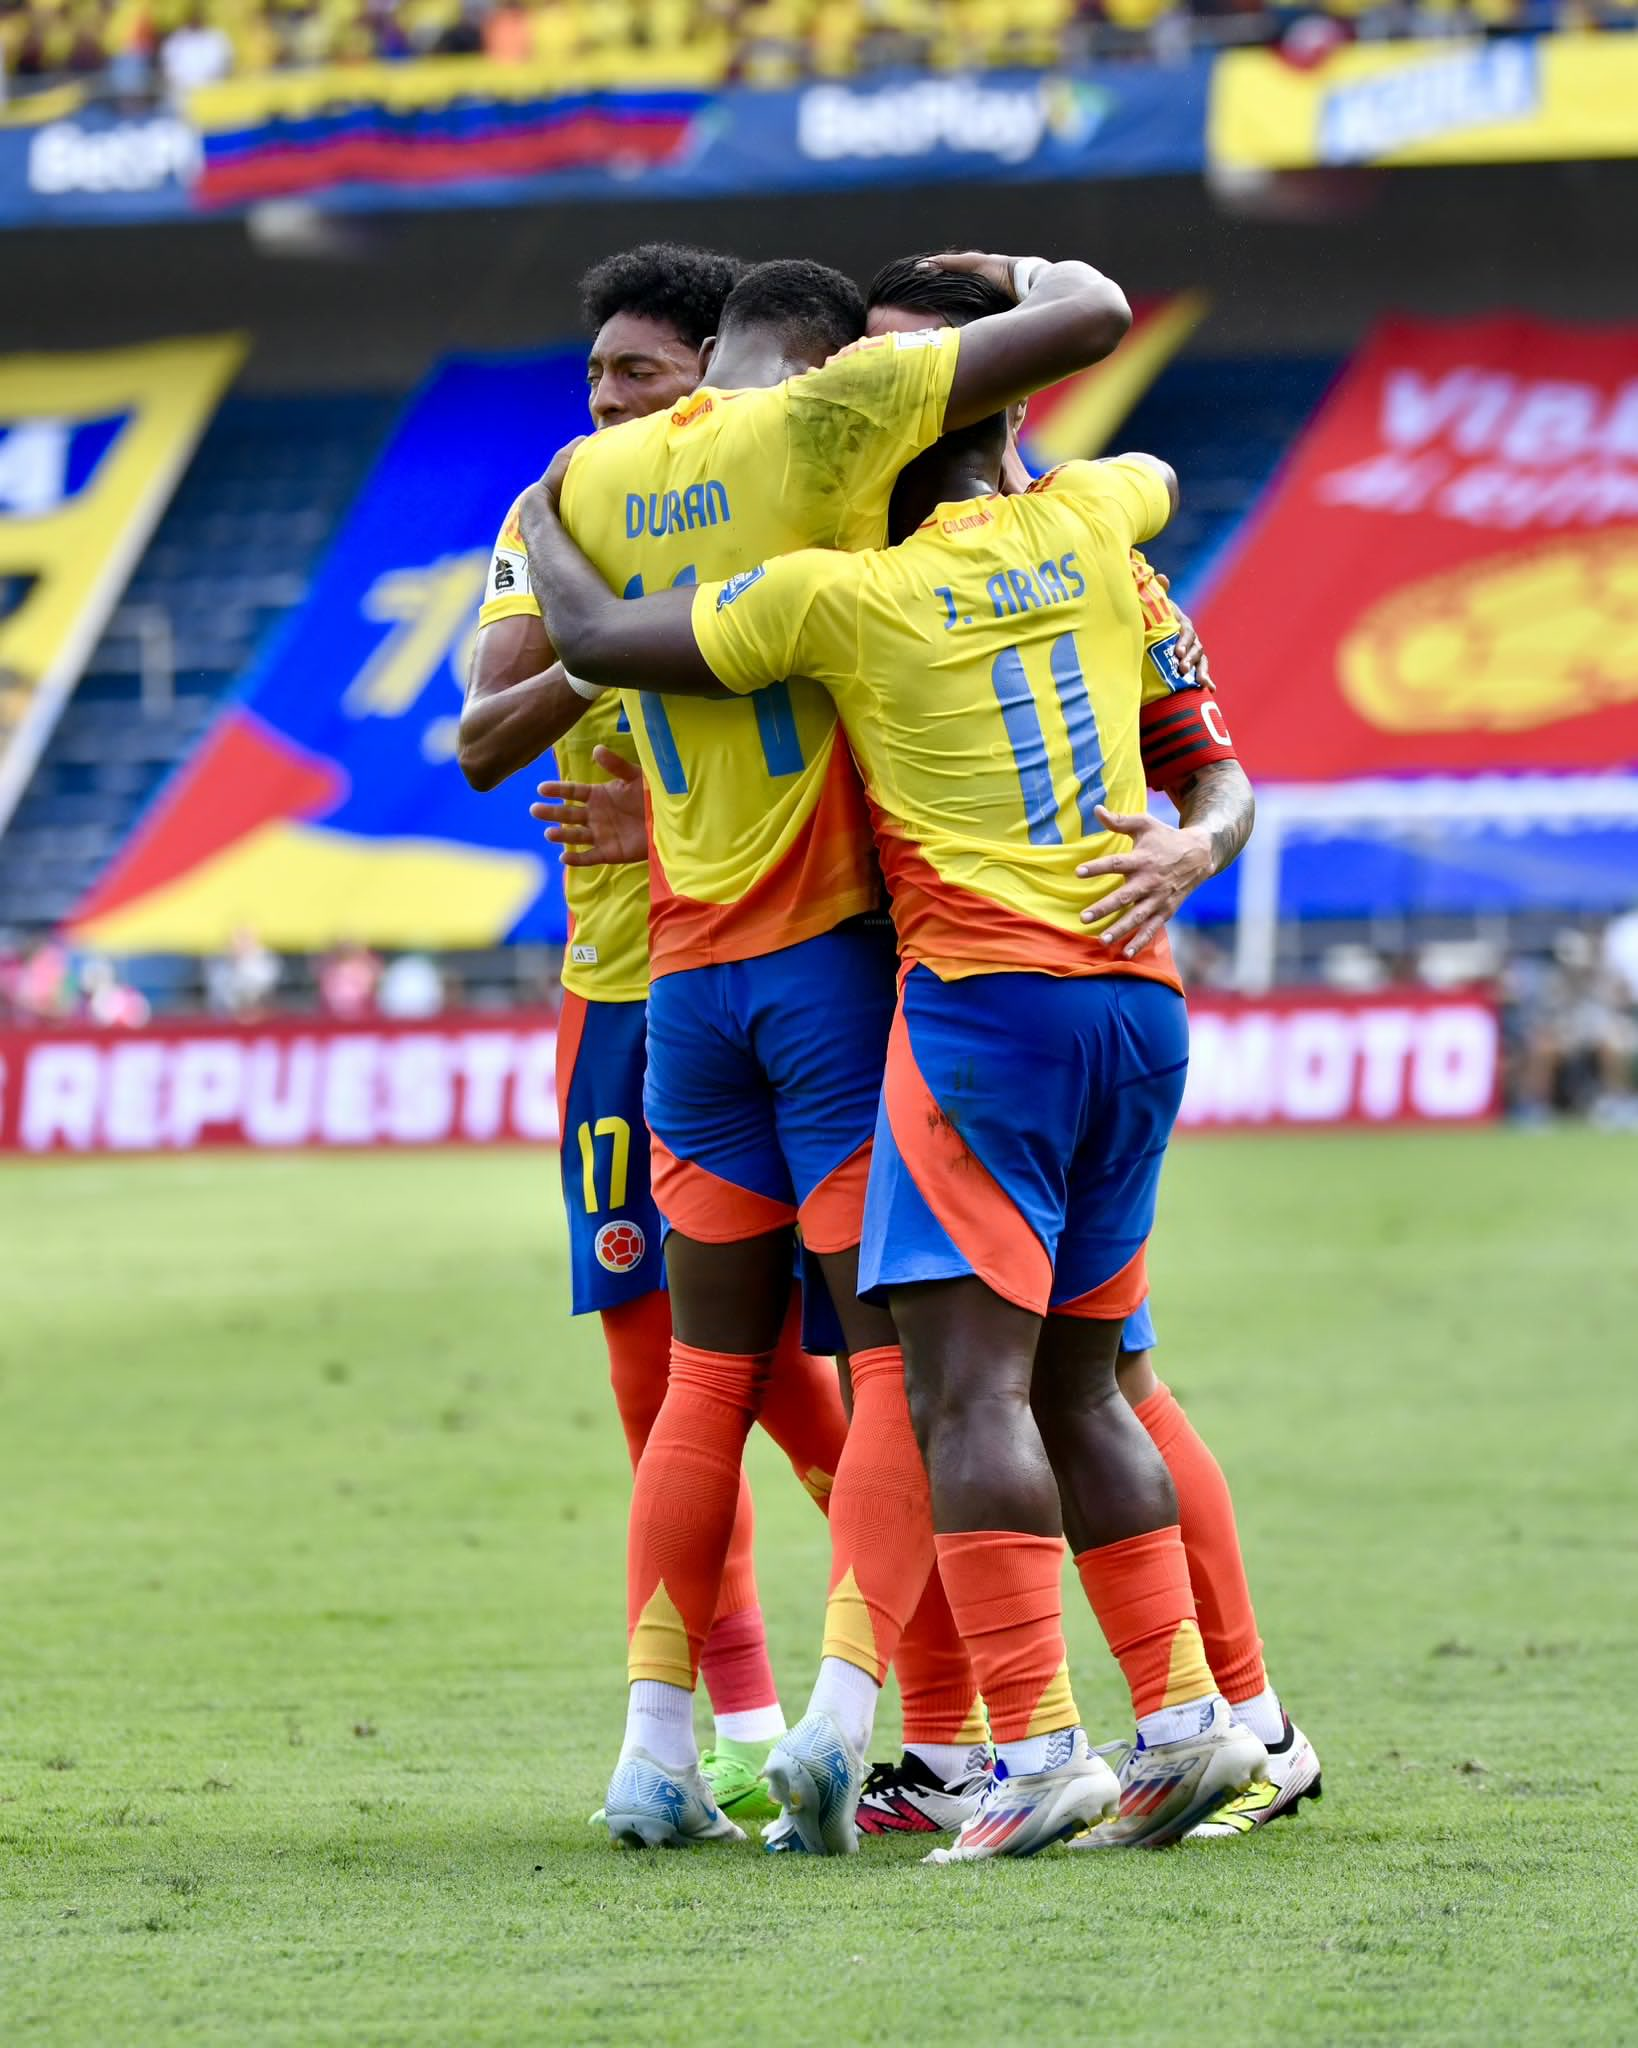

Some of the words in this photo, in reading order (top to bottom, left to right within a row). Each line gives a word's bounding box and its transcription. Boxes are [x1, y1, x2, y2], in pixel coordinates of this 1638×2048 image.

[626, 480, 731, 539] DURAN
[934, 586, 972, 630] J.
[986, 552, 1085, 618] ARIAS
[992, 631, 1107, 845] 11
[1201, 701, 1233, 746] C
[578, 1116, 631, 1214] 17
